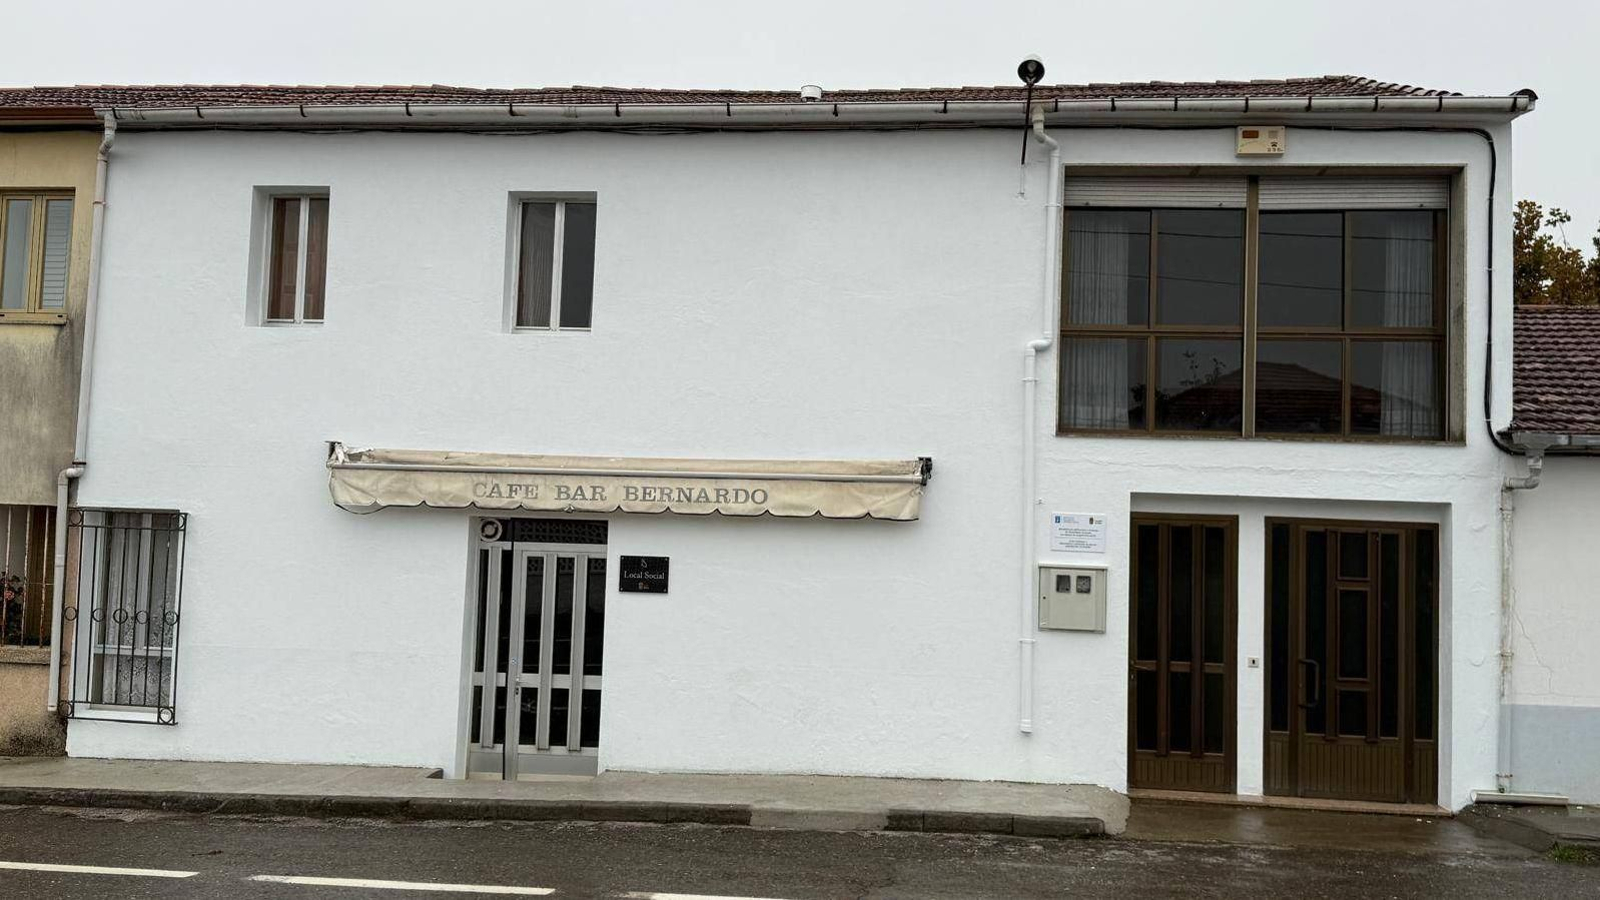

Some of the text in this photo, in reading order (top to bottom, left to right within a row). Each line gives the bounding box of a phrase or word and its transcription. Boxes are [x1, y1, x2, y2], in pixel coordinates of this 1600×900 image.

[472, 482, 768, 505] CAFE BAR BERNARDO
[623, 570, 665, 580] Local Social
